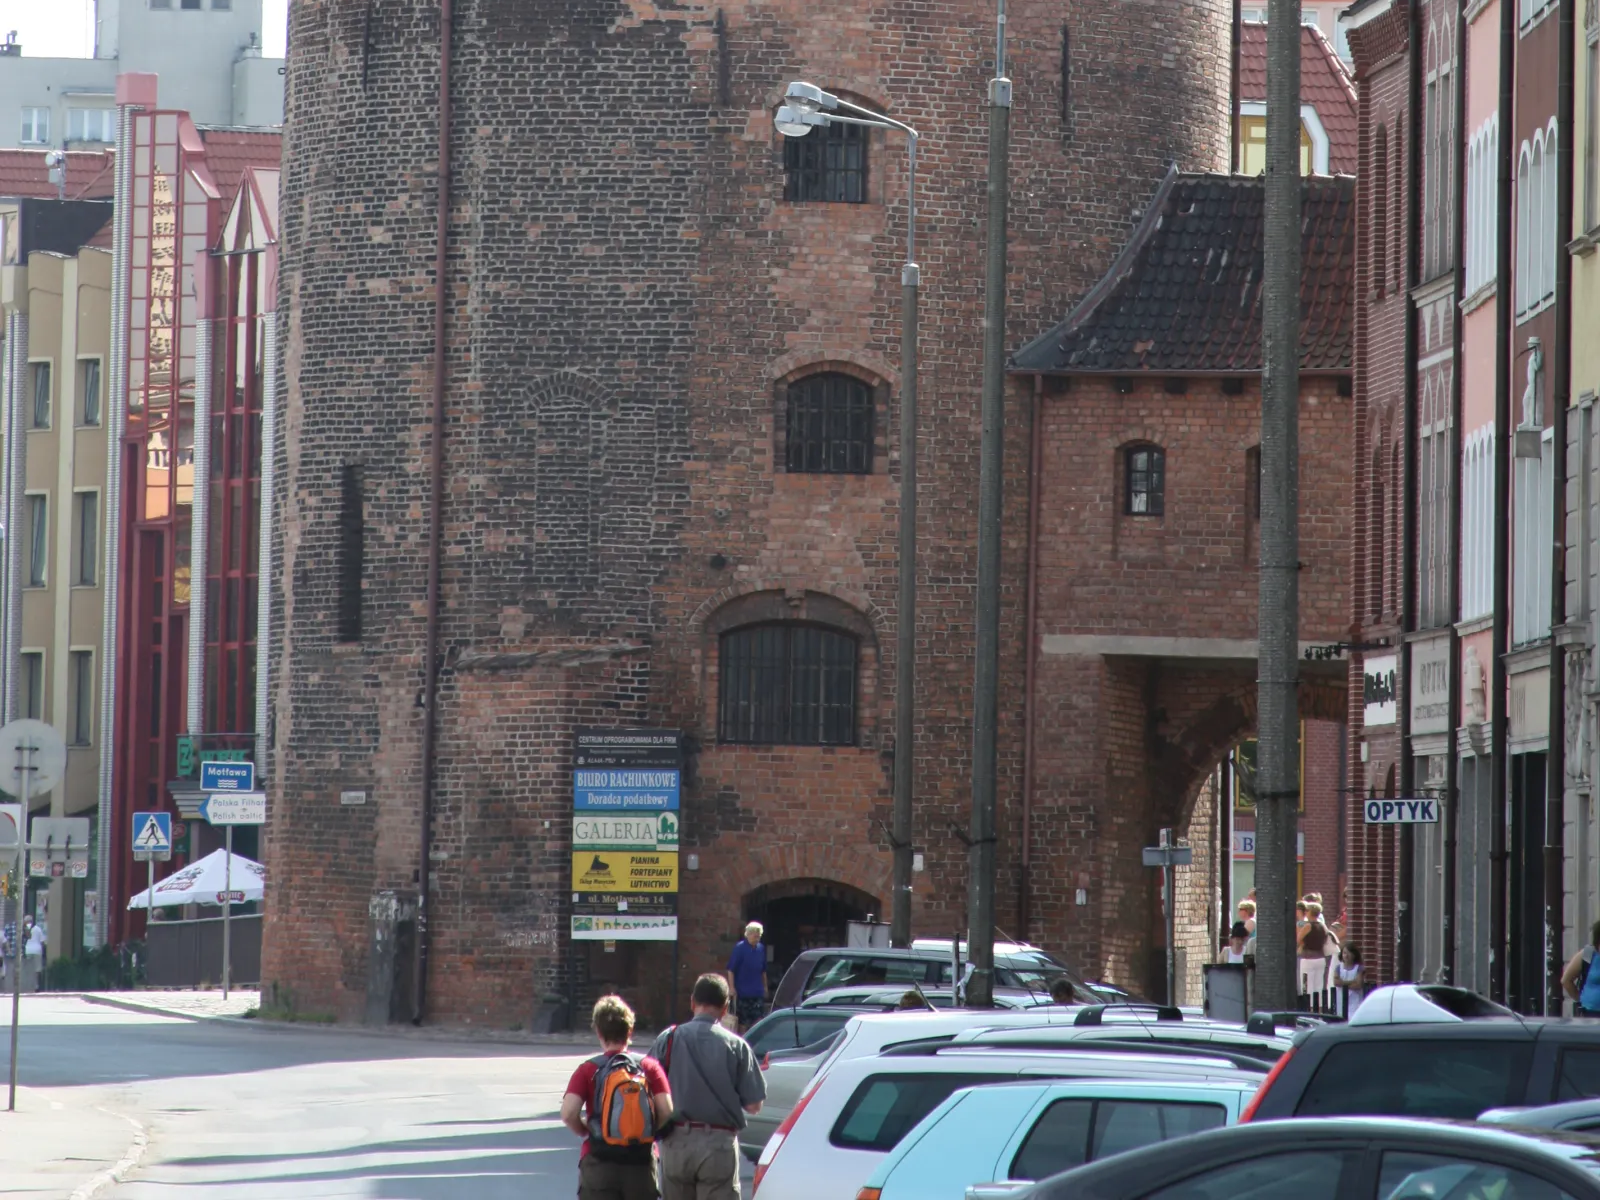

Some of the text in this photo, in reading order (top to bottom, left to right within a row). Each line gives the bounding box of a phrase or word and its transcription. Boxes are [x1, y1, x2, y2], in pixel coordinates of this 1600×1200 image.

[578, 736, 604, 744] CENTRUM
[652, 736, 663, 744] DLA
[664, 736, 676, 744] FIRM
[577, 772, 676, 788] BIURO RACHUNKOWE
[212, 799, 238, 807] Polska
[588, 792, 668, 807] Doradca podatkowy
[1367, 801, 1434, 821] OPTYK
[212, 812, 236, 820] Polish
[574, 822, 654, 840] GALERIA
[630, 856, 660, 864] PIANINA
[630, 868, 673, 876] FORTEPIANY
[630, 880, 670, 888] LUTNICTWO
[588, 895, 600, 903] ul.
